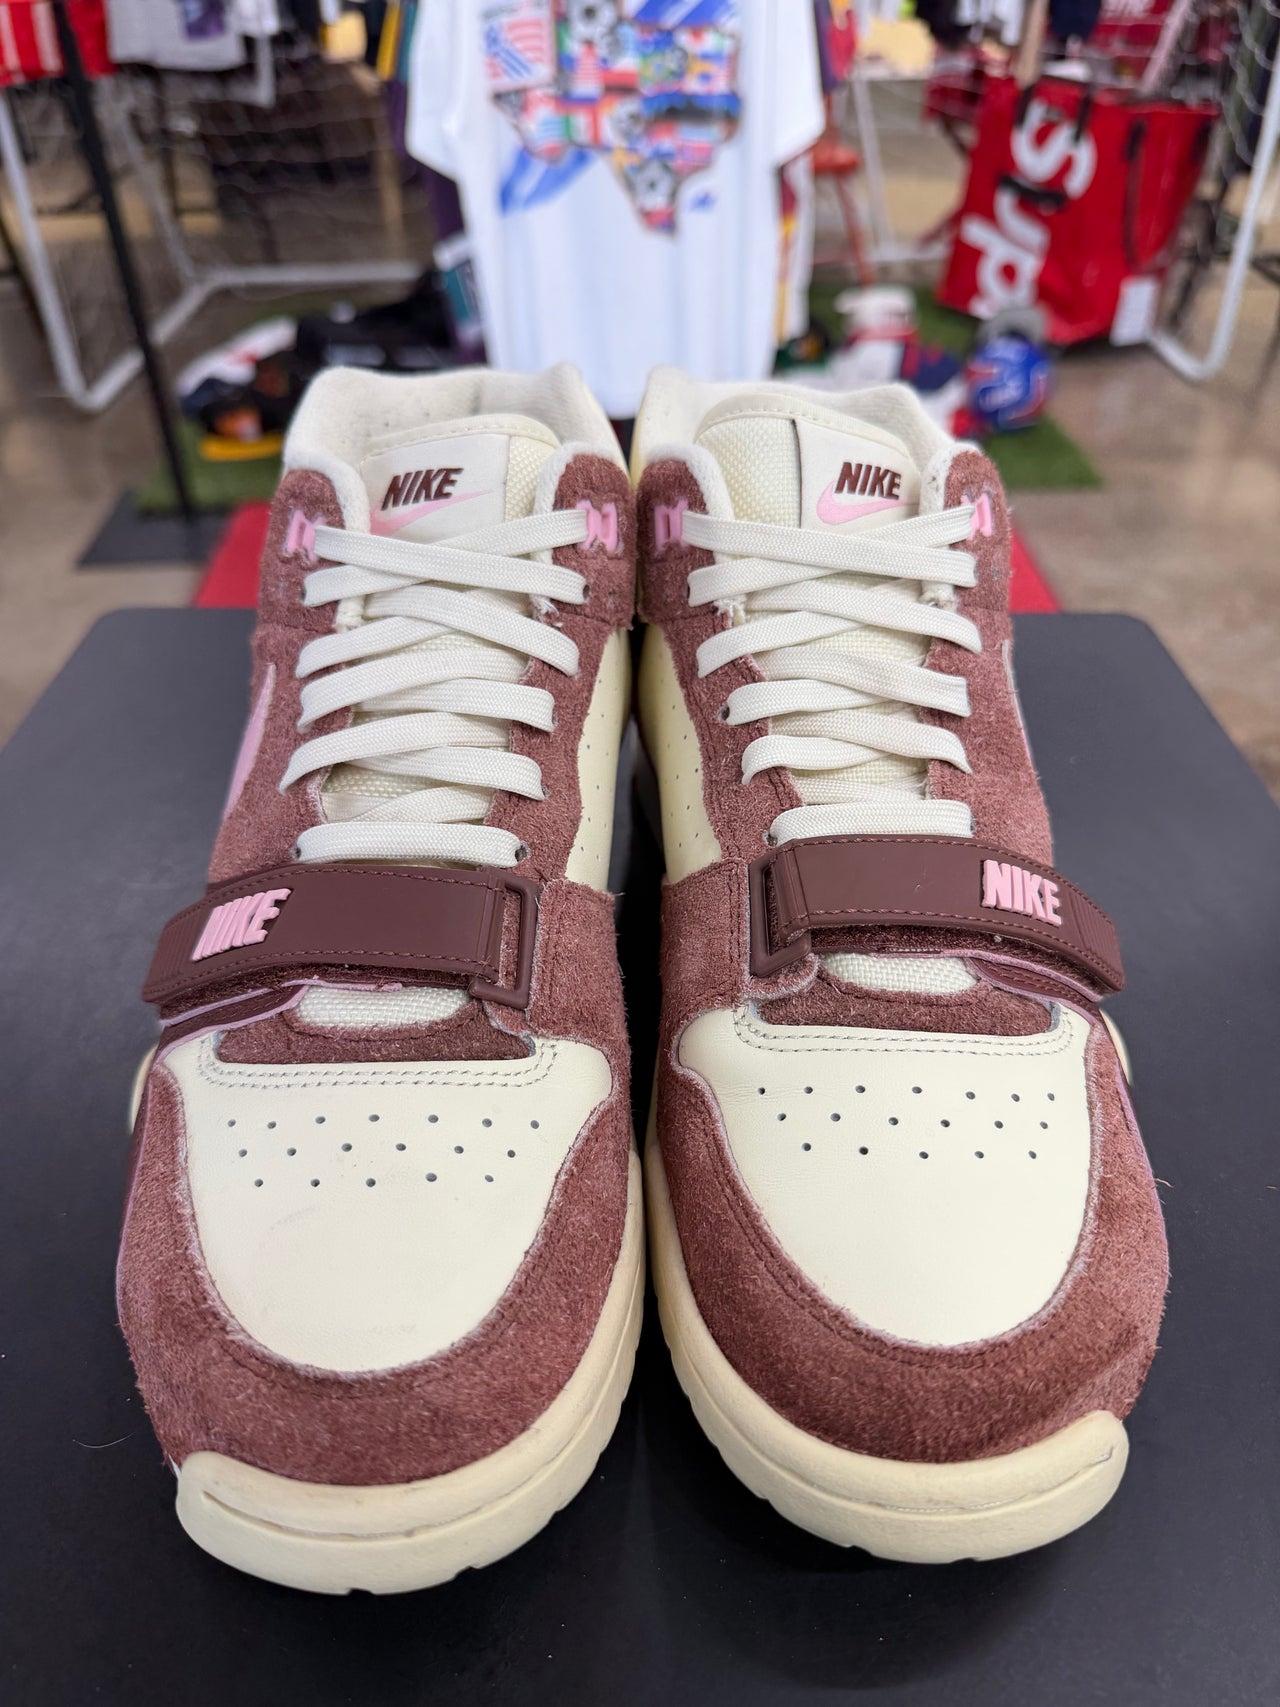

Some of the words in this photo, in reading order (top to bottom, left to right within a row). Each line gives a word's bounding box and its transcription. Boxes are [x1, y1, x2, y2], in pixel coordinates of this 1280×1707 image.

[959, 97, 1097, 319] Sup
[381, 467, 464, 511] NIKE
[835, 461, 902, 500] NIKE
[191, 887, 292, 961] NIKE
[981, 859, 1062, 926] NIKE
